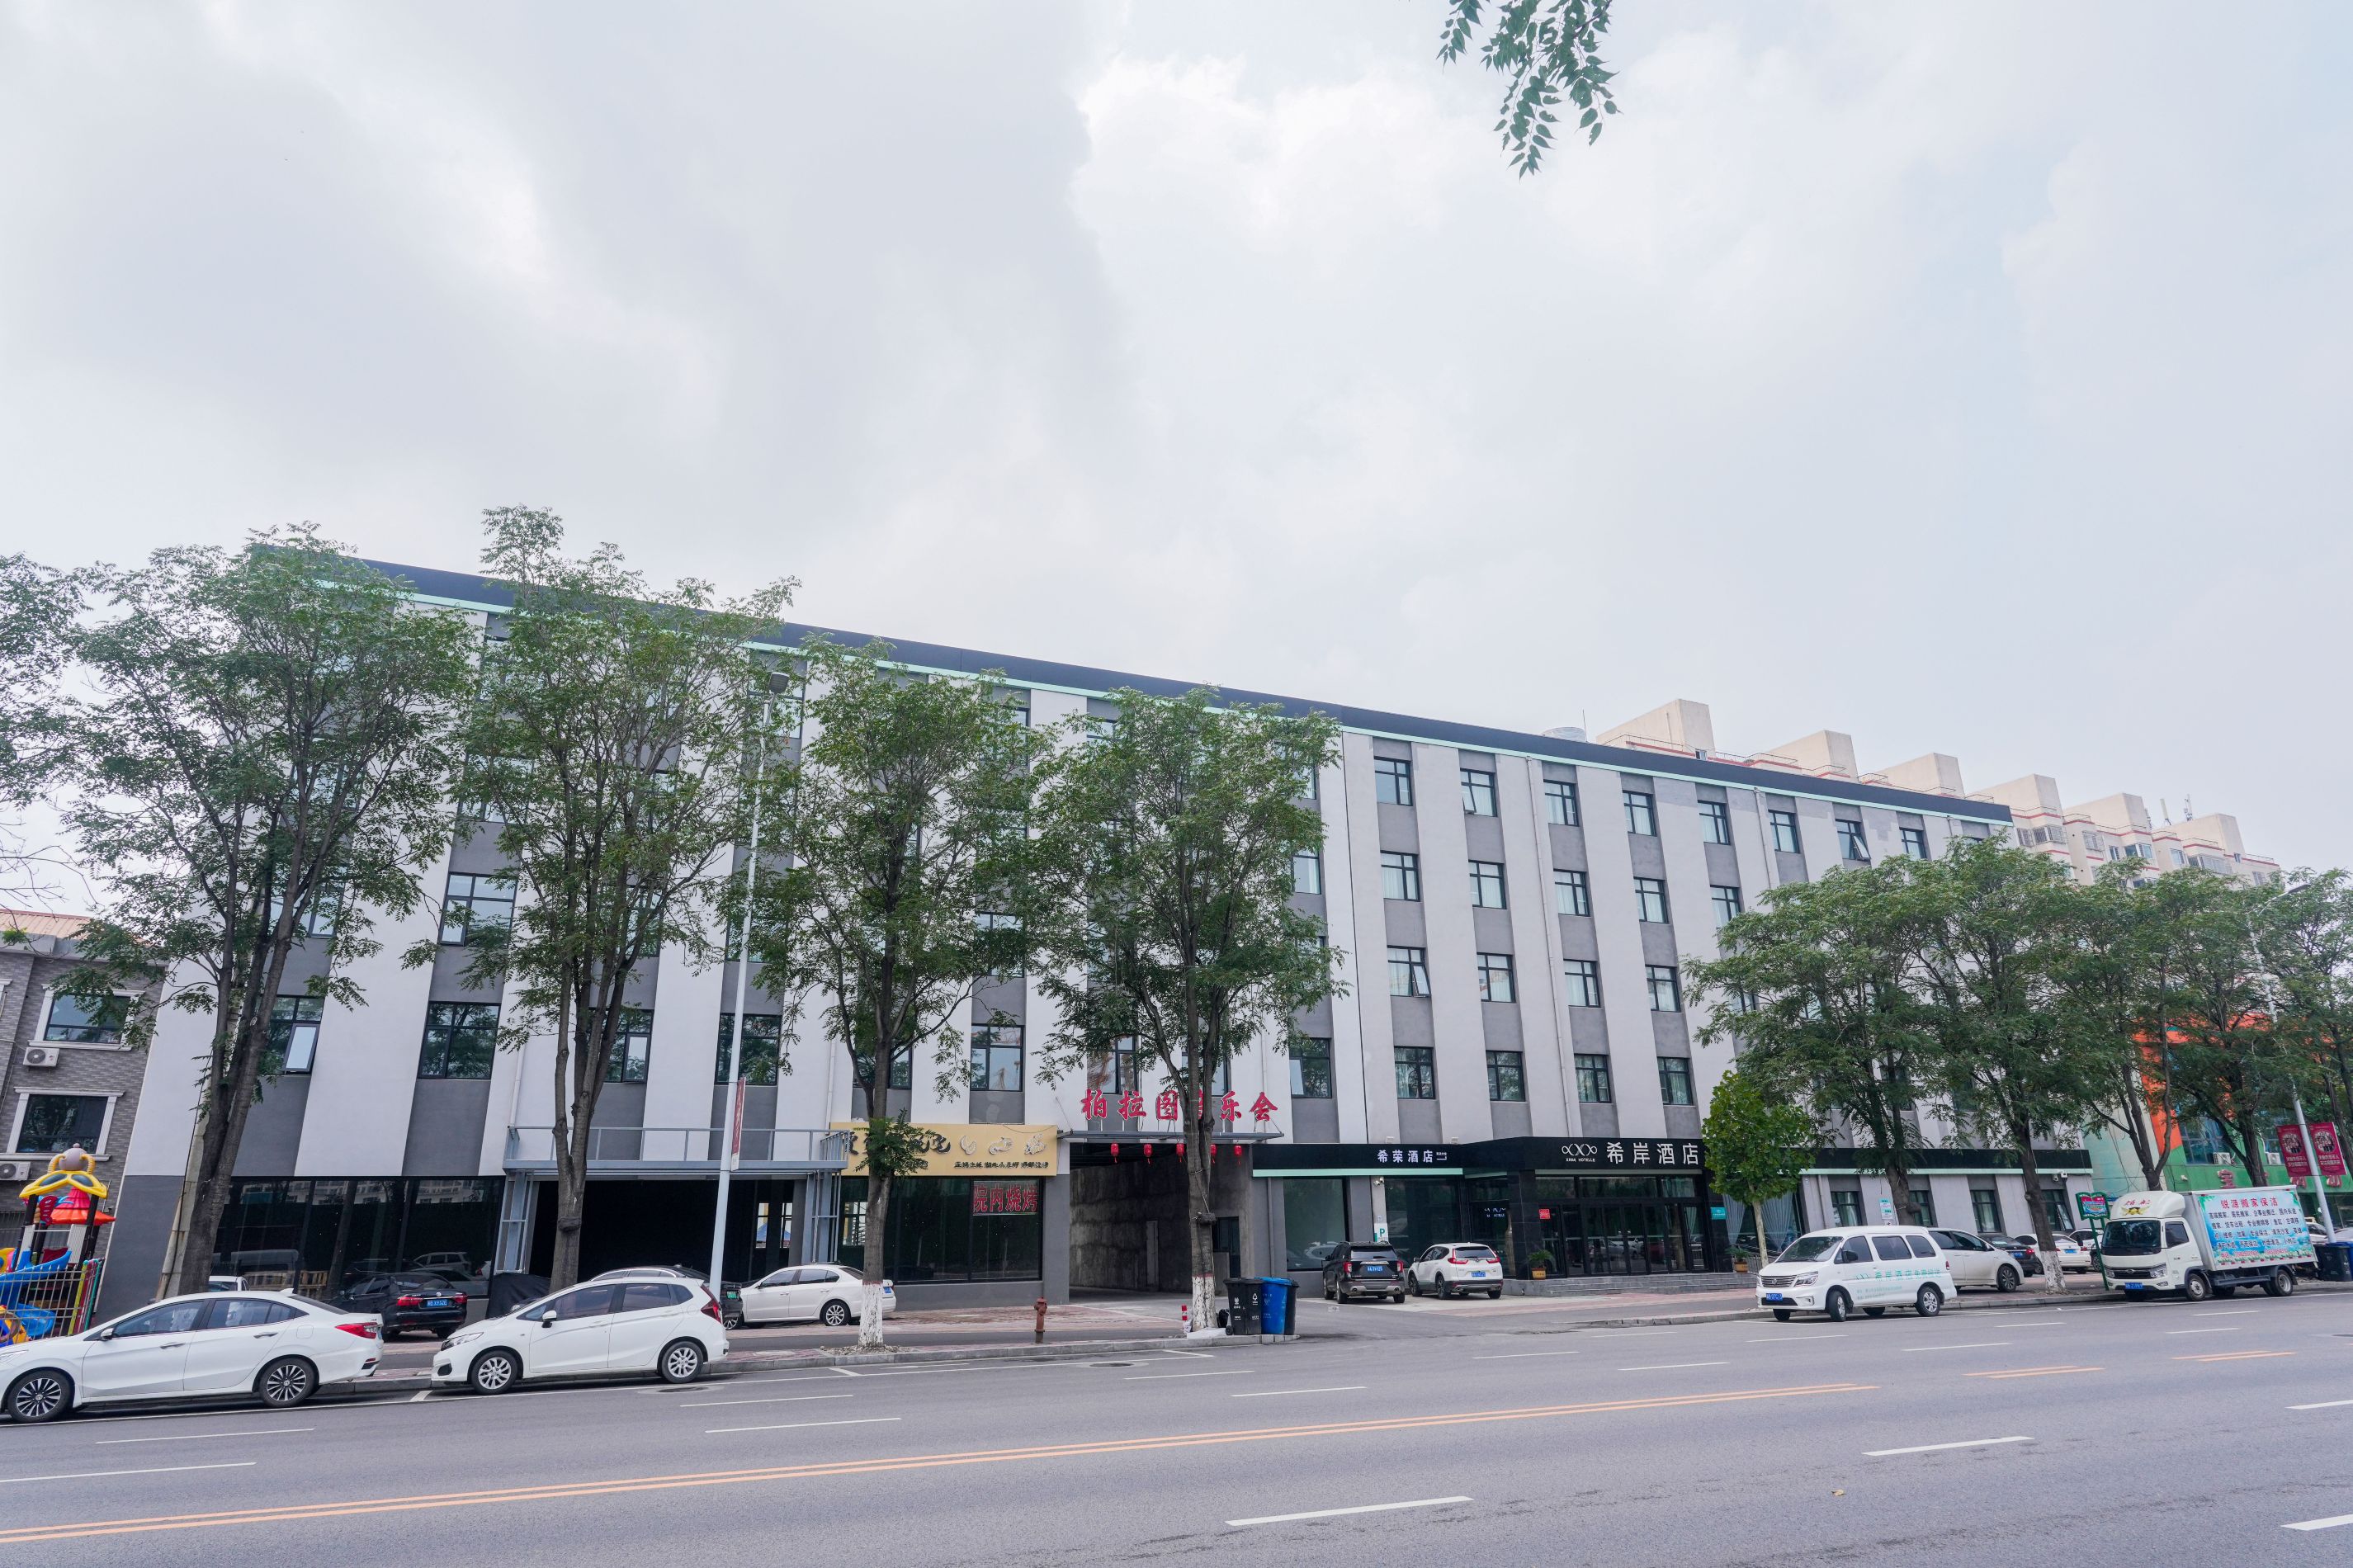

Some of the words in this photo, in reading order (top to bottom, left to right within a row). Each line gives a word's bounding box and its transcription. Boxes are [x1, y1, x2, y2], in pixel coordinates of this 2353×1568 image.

[1080, 1089, 1278, 1122] 柏拉图乐会
[1377, 1149, 1434, 1163] 希荣酒店
[1606, 1141, 1699, 1165] 希岸酒店
[972, 1183, 1038, 1213] 院内烧烤
[1379, 1228, 1386, 1237] P
